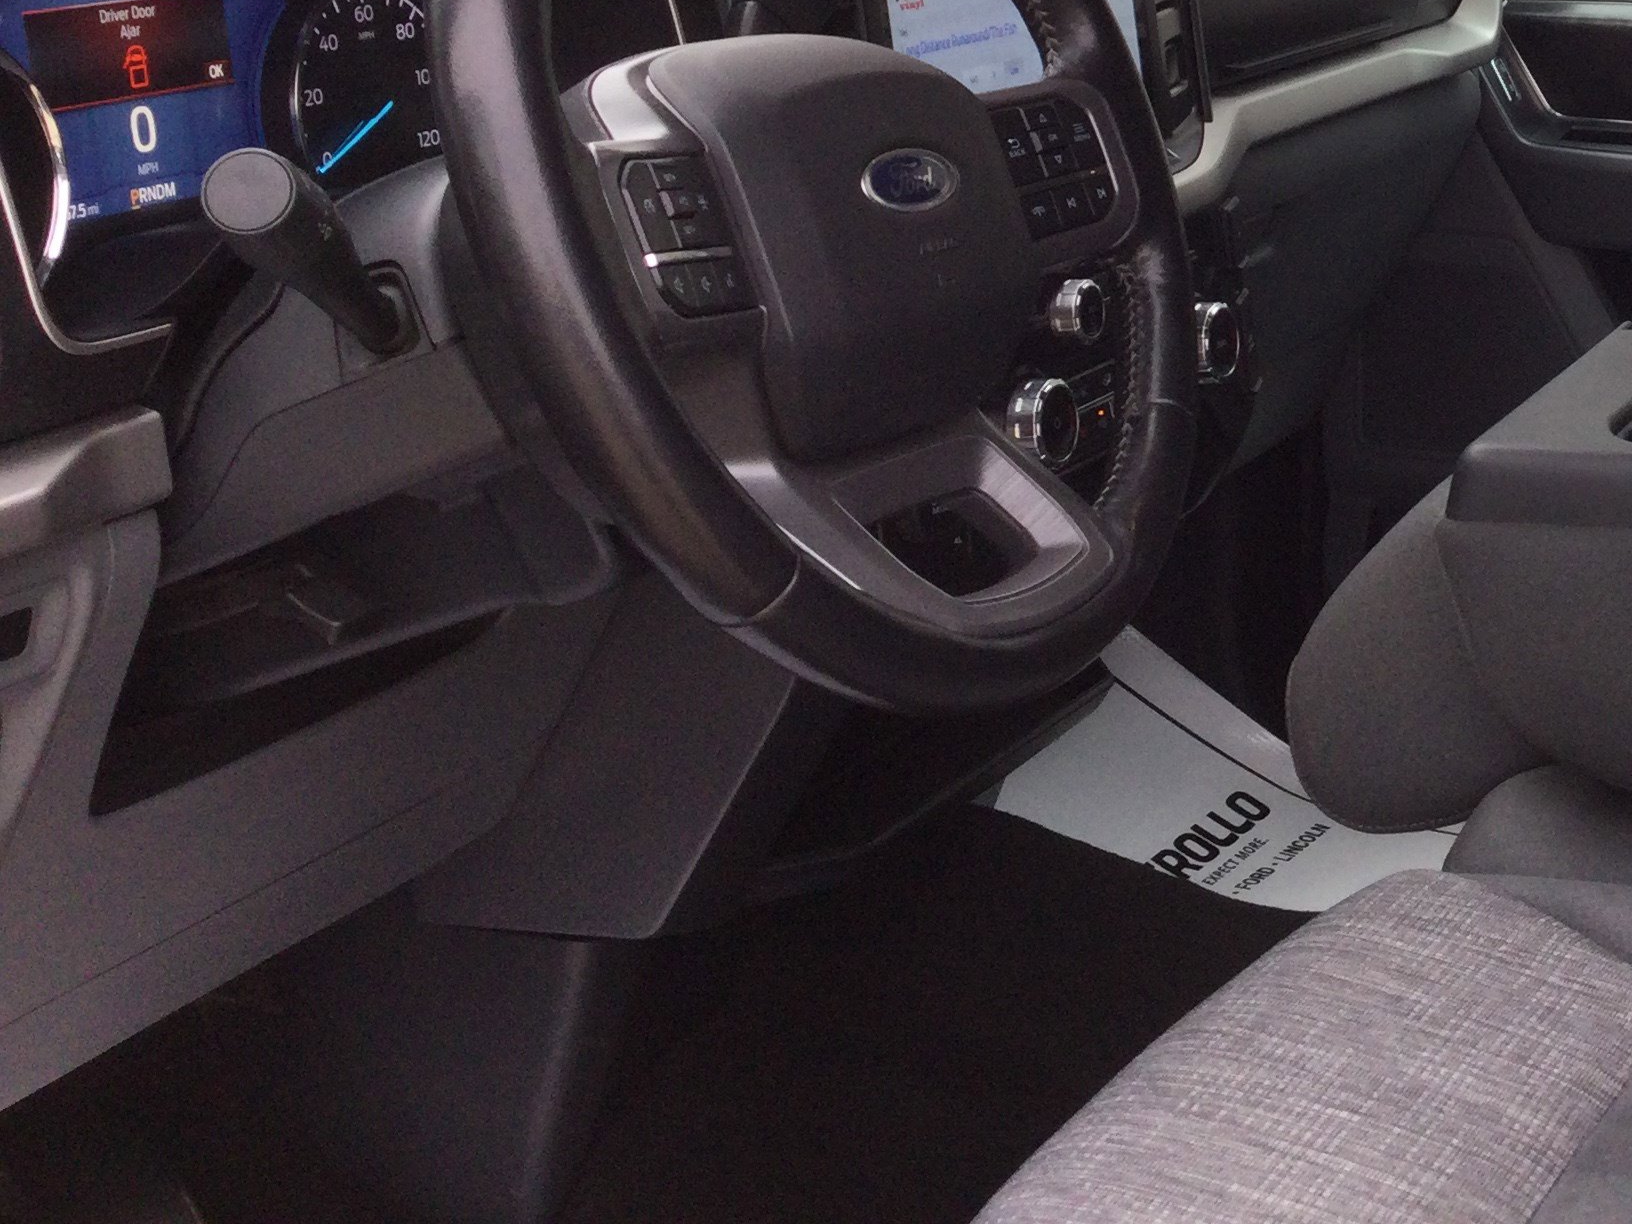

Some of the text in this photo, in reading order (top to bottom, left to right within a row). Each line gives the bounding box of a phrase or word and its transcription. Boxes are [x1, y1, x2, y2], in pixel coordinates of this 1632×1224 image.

[99, 5, 156, 24] Driver Door
[354, 4, 375, 23] 60
[120, 24, 141, 40] Ajar
[395, 22, 416, 40] 80
[319, 34, 339, 52] 40
[208, 63, 225, 79] OK
[415, 68, 431, 86] 10
[304, 88, 324, 107] 20
[130, 105, 157, 153] 0
[417, 129, 441, 148] 120
[137, 161, 159, 176] MPH
[130, 181, 177, 206] PRNDM
[1145, 790, 1271, 880] ROLLO
[1235, 822, 1331, 891] FORD LINCOLN
[1202, 857, 1240, 886] EXPECT
